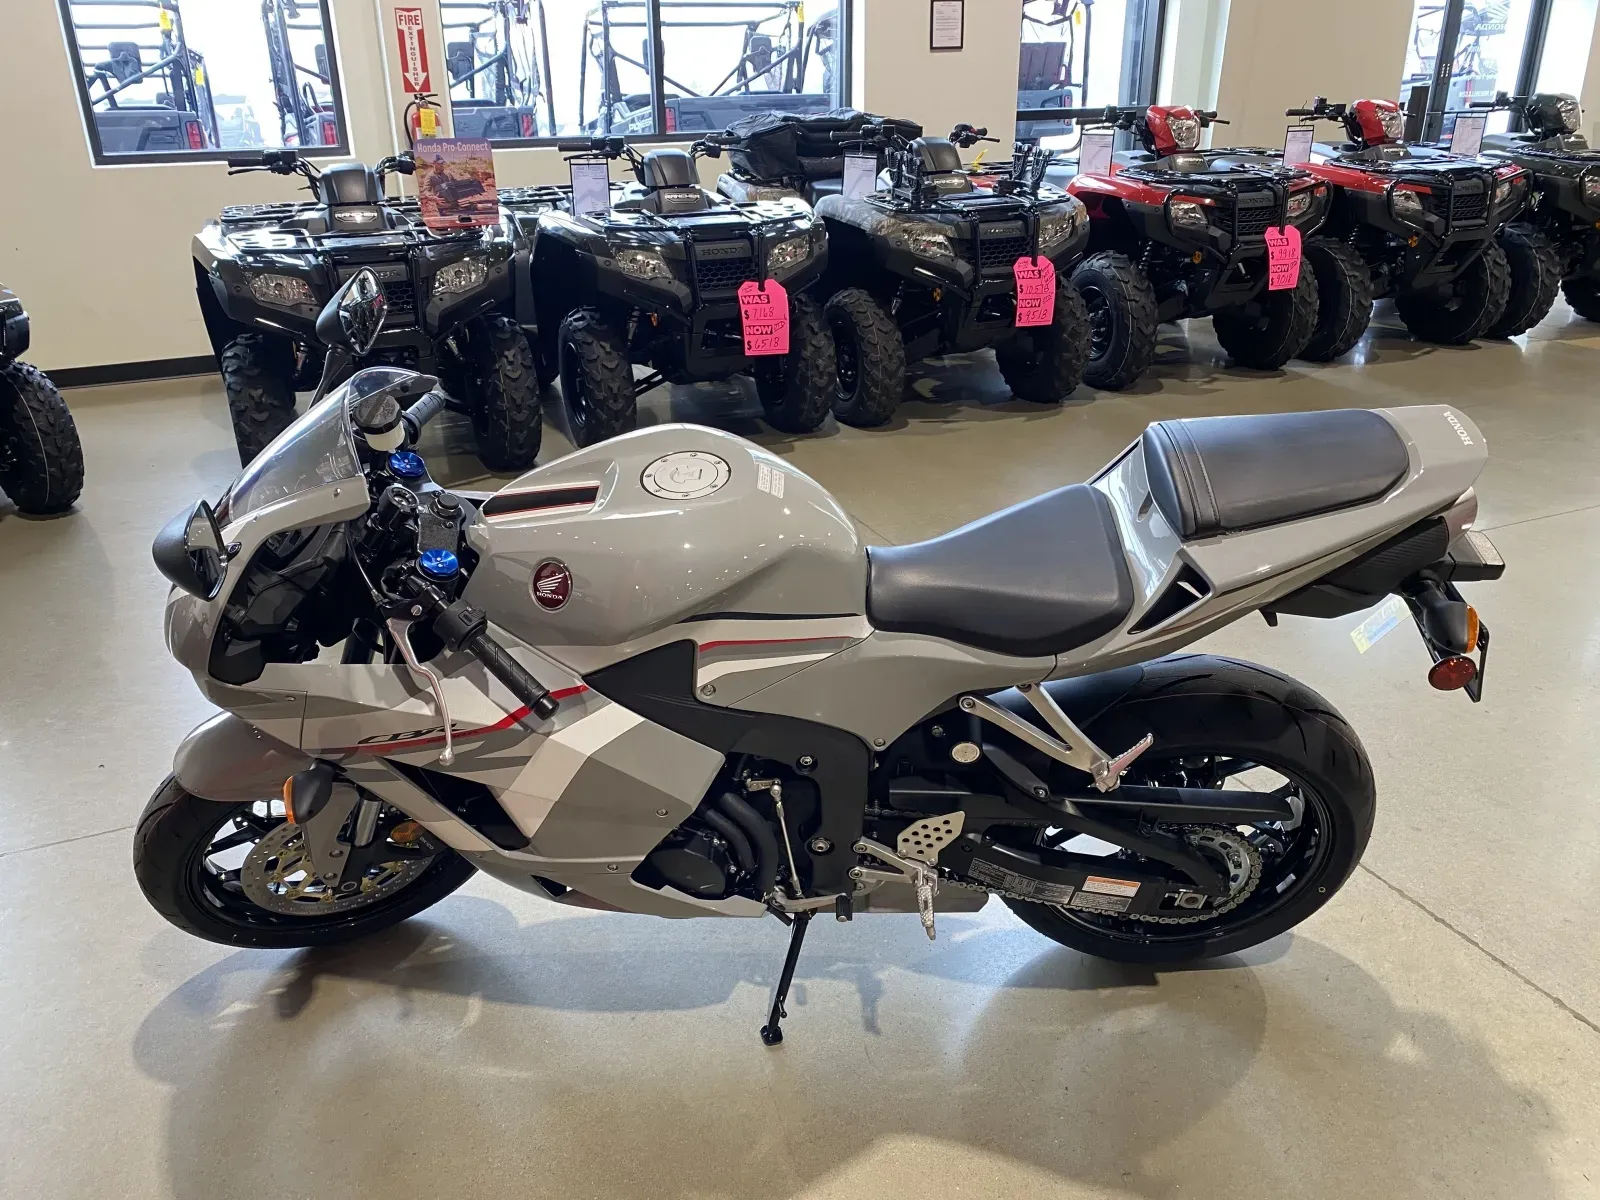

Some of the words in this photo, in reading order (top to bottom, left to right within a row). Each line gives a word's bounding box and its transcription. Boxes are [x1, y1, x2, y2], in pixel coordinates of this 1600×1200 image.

[398, 14, 420, 26] FIRE
[408, 26, 420, 86] EXTINGUISHER
[417, 143, 441, 153] Honda
[442, 141, 489, 152] Pro-Connect
[1240, 197, 1272, 205] HONDA
[1268, 238, 1288, 247] WAS
[701, 246, 746, 257] HONDA
[1271, 251, 1275, 260] $
[1271, 264, 1289, 273] NOW
[1017, 270, 1039, 279] WAS
[1271, 277, 1275, 286] $
[1019, 284, 1023, 294] $
[741, 295, 768, 304] WAS
[1019, 298, 1040, 308] NOW
[744, 310, 749, 320] $
[1018, 312, 1022, 323] $
[745, 325, 773, 335] NOW
[747, 341, 751, 351] $
[1443, 411, 1474, 445] HONDA
[536, 591, 564, 601] HONDA
